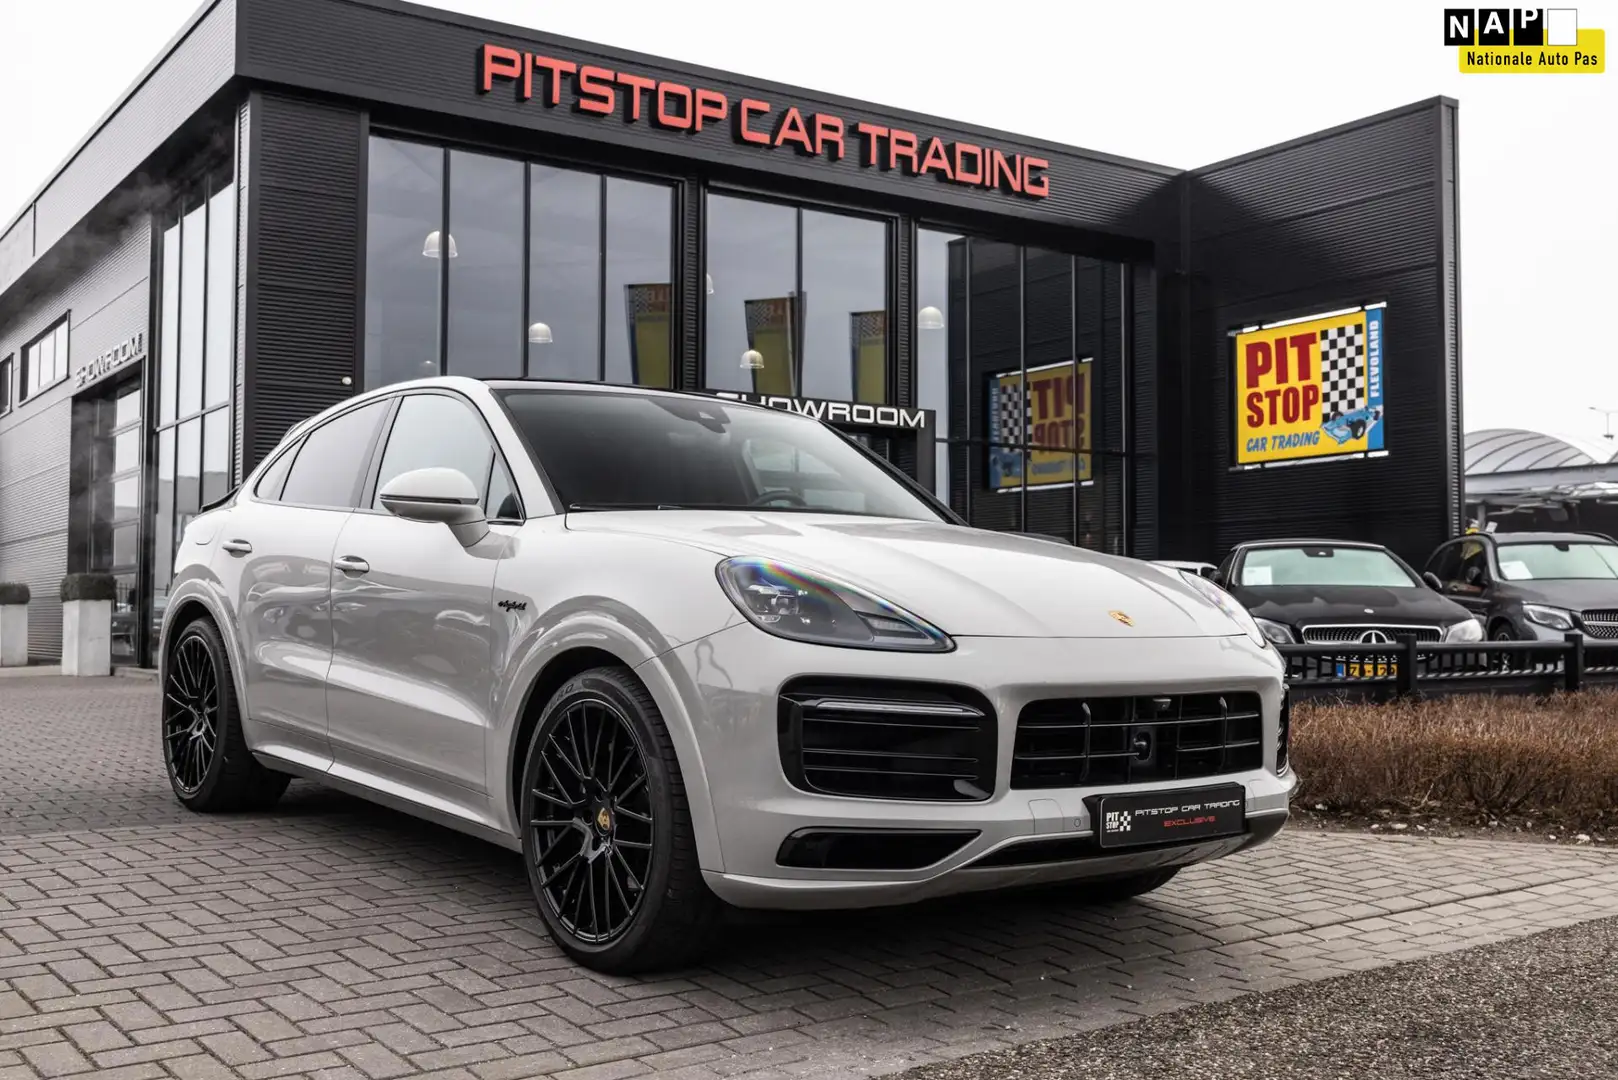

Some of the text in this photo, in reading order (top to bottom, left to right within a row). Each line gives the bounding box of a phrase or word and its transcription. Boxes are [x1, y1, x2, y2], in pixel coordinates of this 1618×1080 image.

[483, 43, 1049, 198] PITSTOP CAR TRADING
[1245, 332, 1317, 389] PIT
[1369, 319, 1381, 398] FLEVOLAND
[715, 392, 925, 428] OWROOM
[1246, 384, 1320, 429] STOP
[1246, 431, 1321, 453] CAR TRADING
[1106, 811, 1120, 821] PIT
[1134, 800, 1240, 816] PITSTOP CAR TRADING
[1163, 815, 1216, 827] EXCLUSIVE
[1106, 821, 1120, 830] STOP
